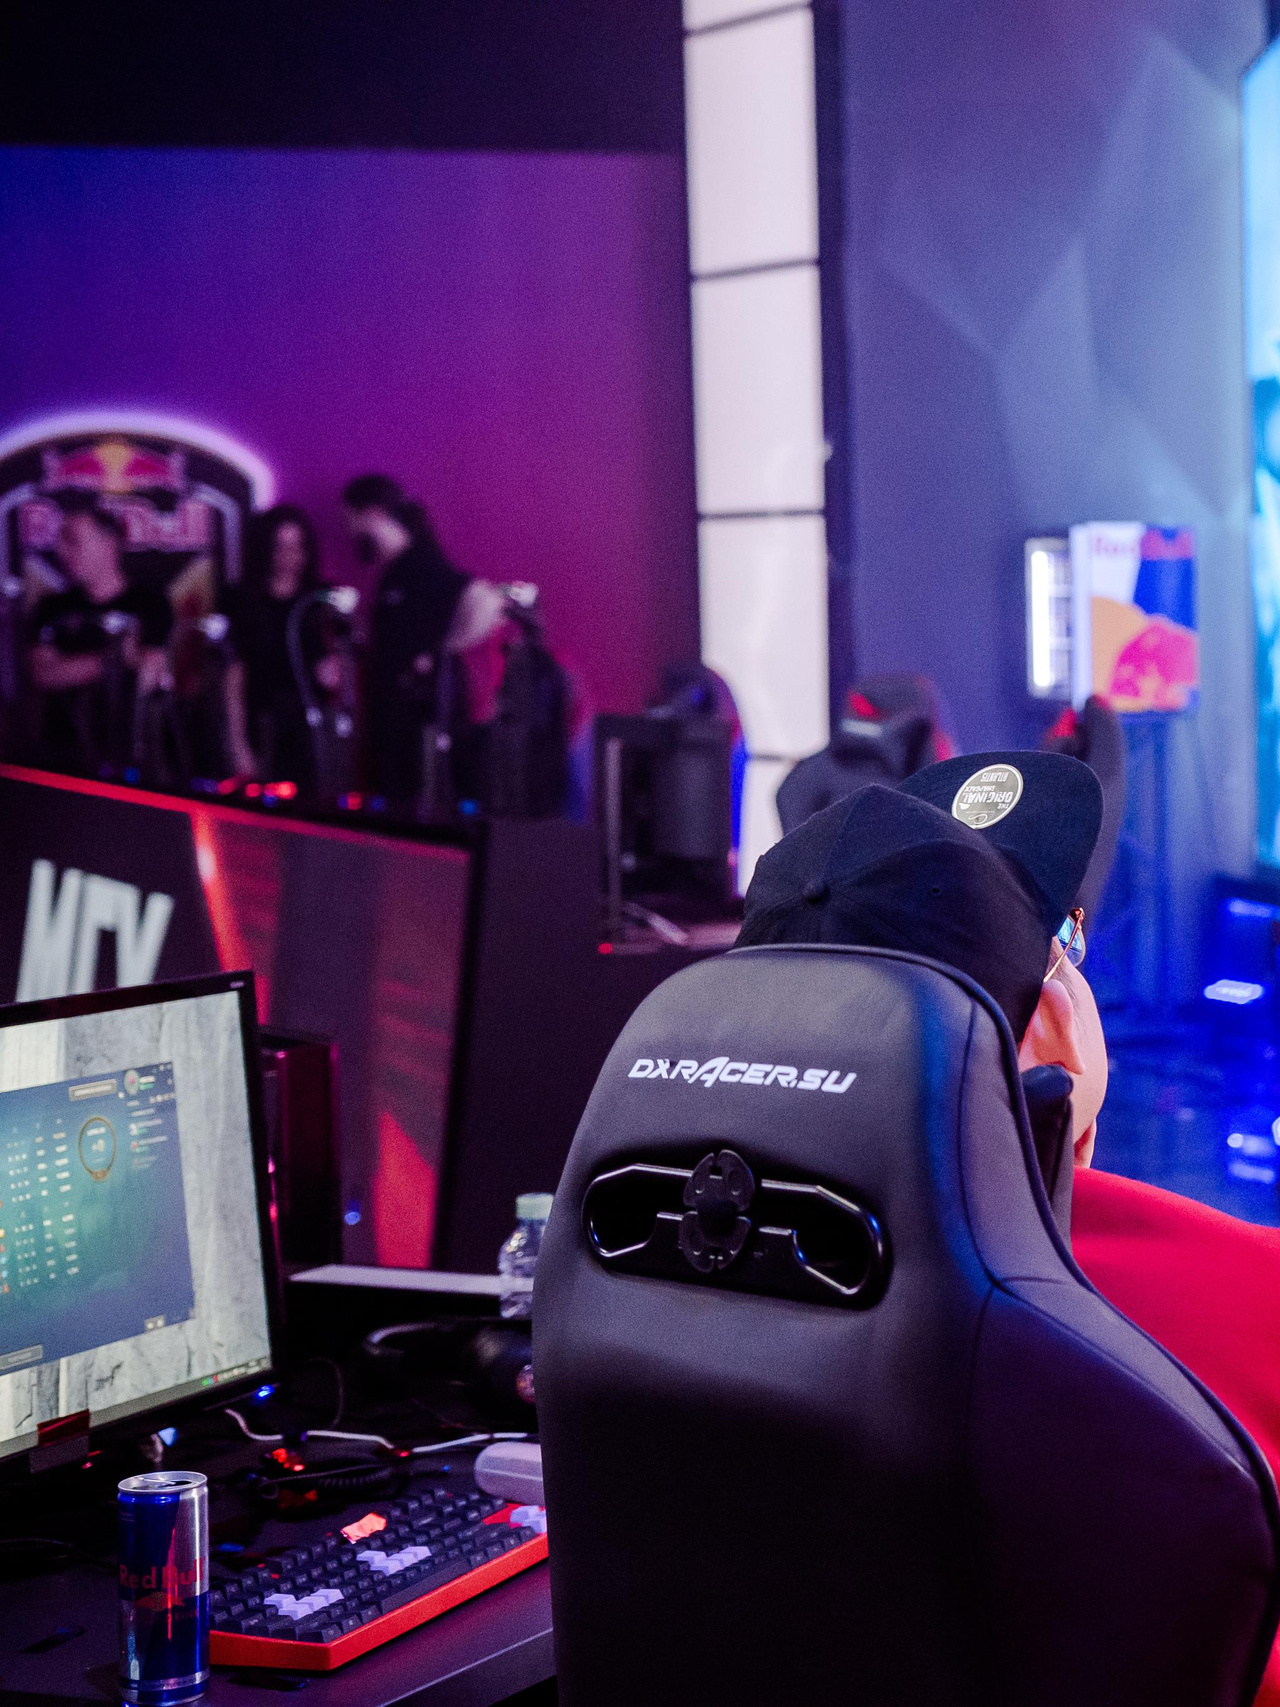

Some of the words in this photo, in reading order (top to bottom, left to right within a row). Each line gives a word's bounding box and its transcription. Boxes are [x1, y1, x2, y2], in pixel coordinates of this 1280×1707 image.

[981, 772, 1009, 782] ATLANTIS
[963, 792, 1013, 803] ORIGINAL
[628, 1056, 857, 1093] DXRACER.SU
[120, 1564, 157, 1589] Red
[162, 1557, 205, 1589] Bull
